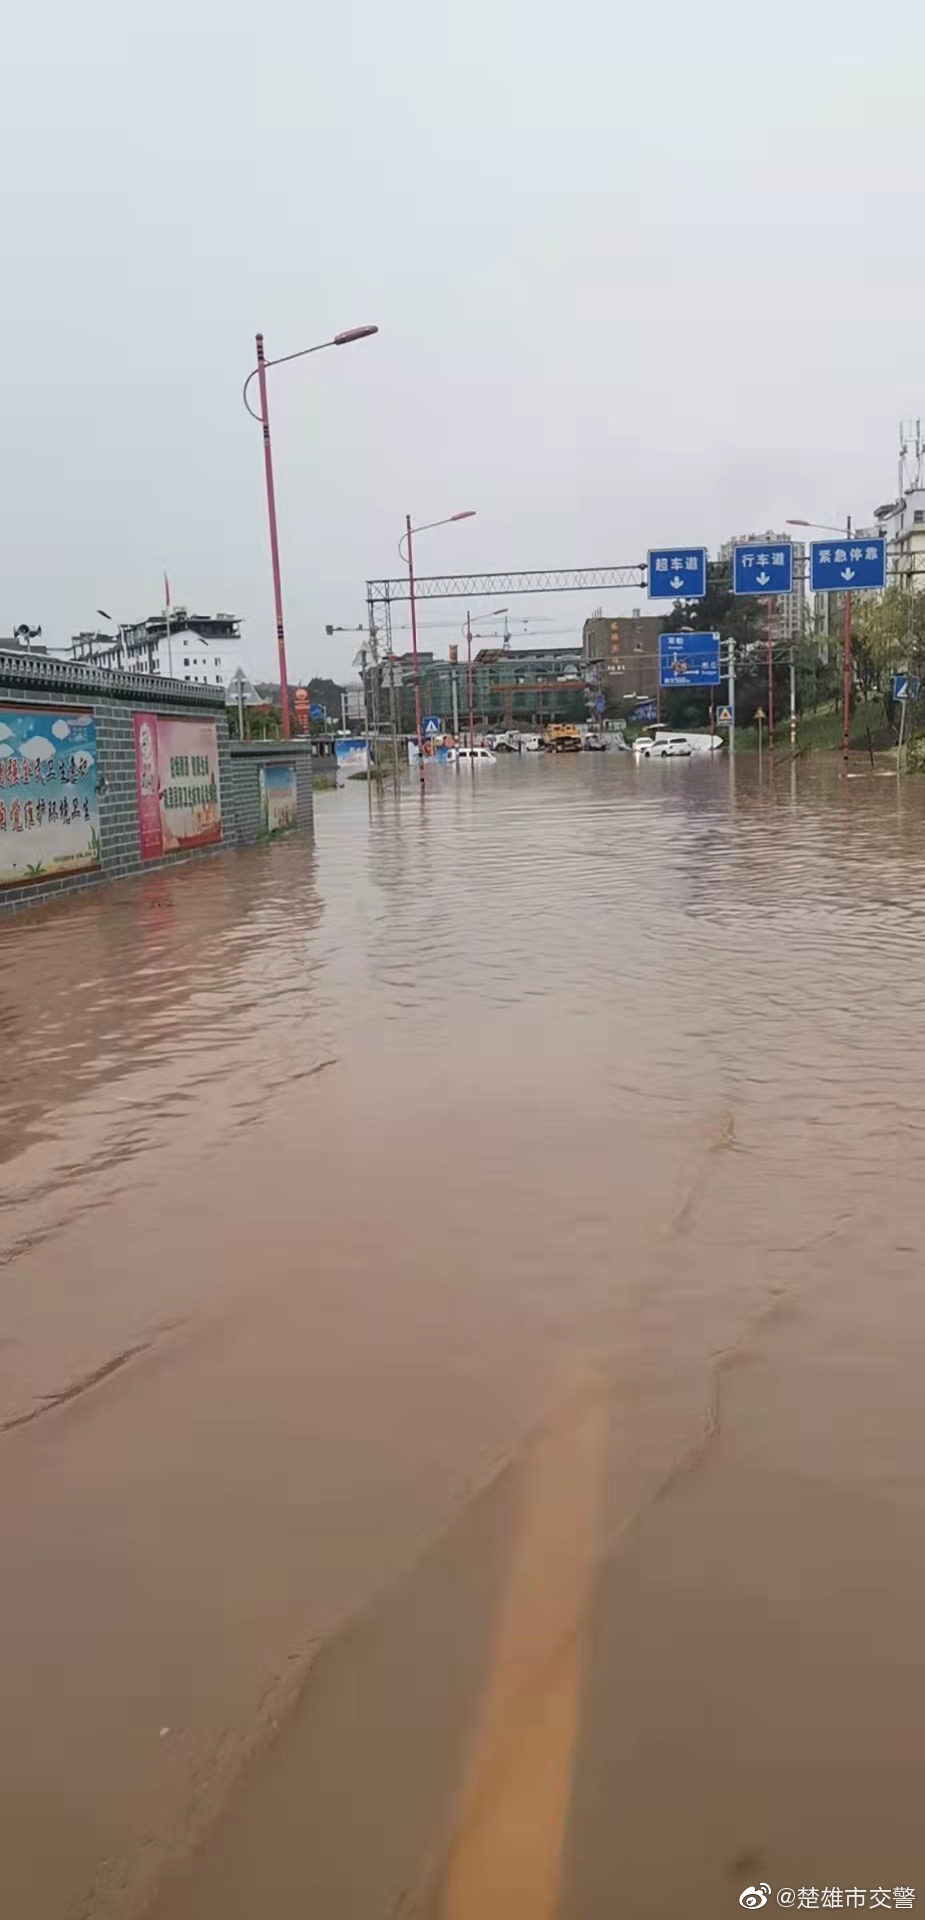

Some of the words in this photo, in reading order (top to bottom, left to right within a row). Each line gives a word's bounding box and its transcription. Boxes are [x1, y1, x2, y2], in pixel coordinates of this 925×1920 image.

[741, 552, 785, 568] 行车道
[818, 547, 879, 564] 紧急停靠
[655, 557, 698, 572] 超车道
